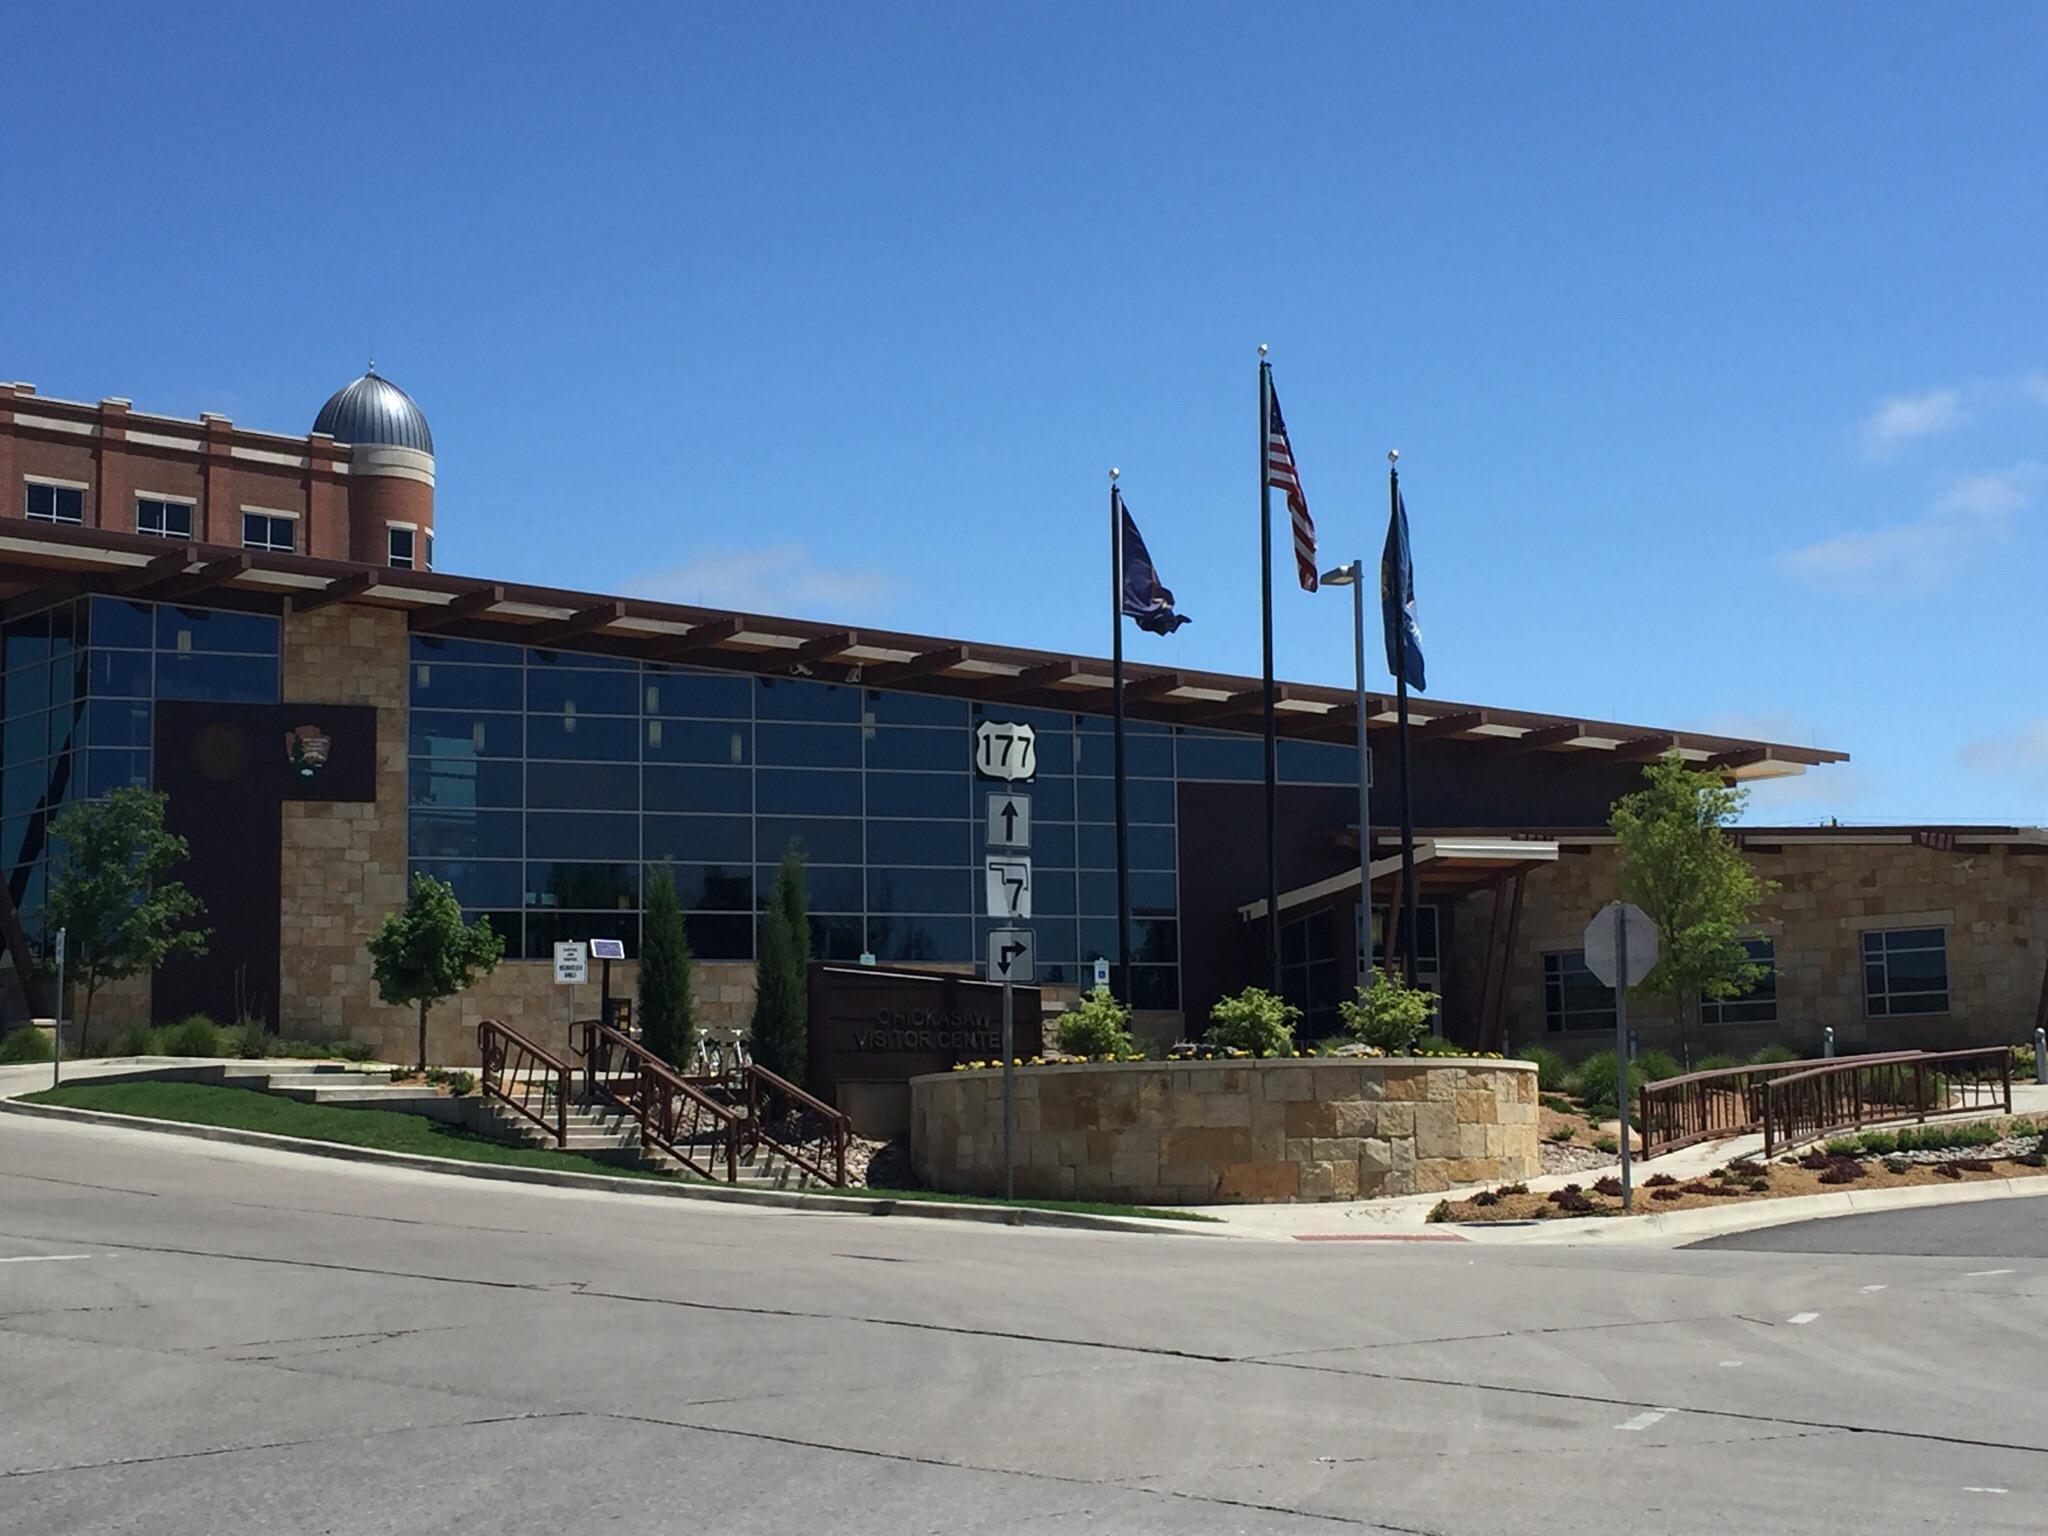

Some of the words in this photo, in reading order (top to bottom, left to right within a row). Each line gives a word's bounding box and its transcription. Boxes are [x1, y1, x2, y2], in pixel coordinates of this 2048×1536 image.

[983, 734, 1030, 767] 177
[1006, 878, 1023, 910] 7
[856, 1029, 931, 1047] VISITOR
[938, 1031, 1000, 1049] CENTE
